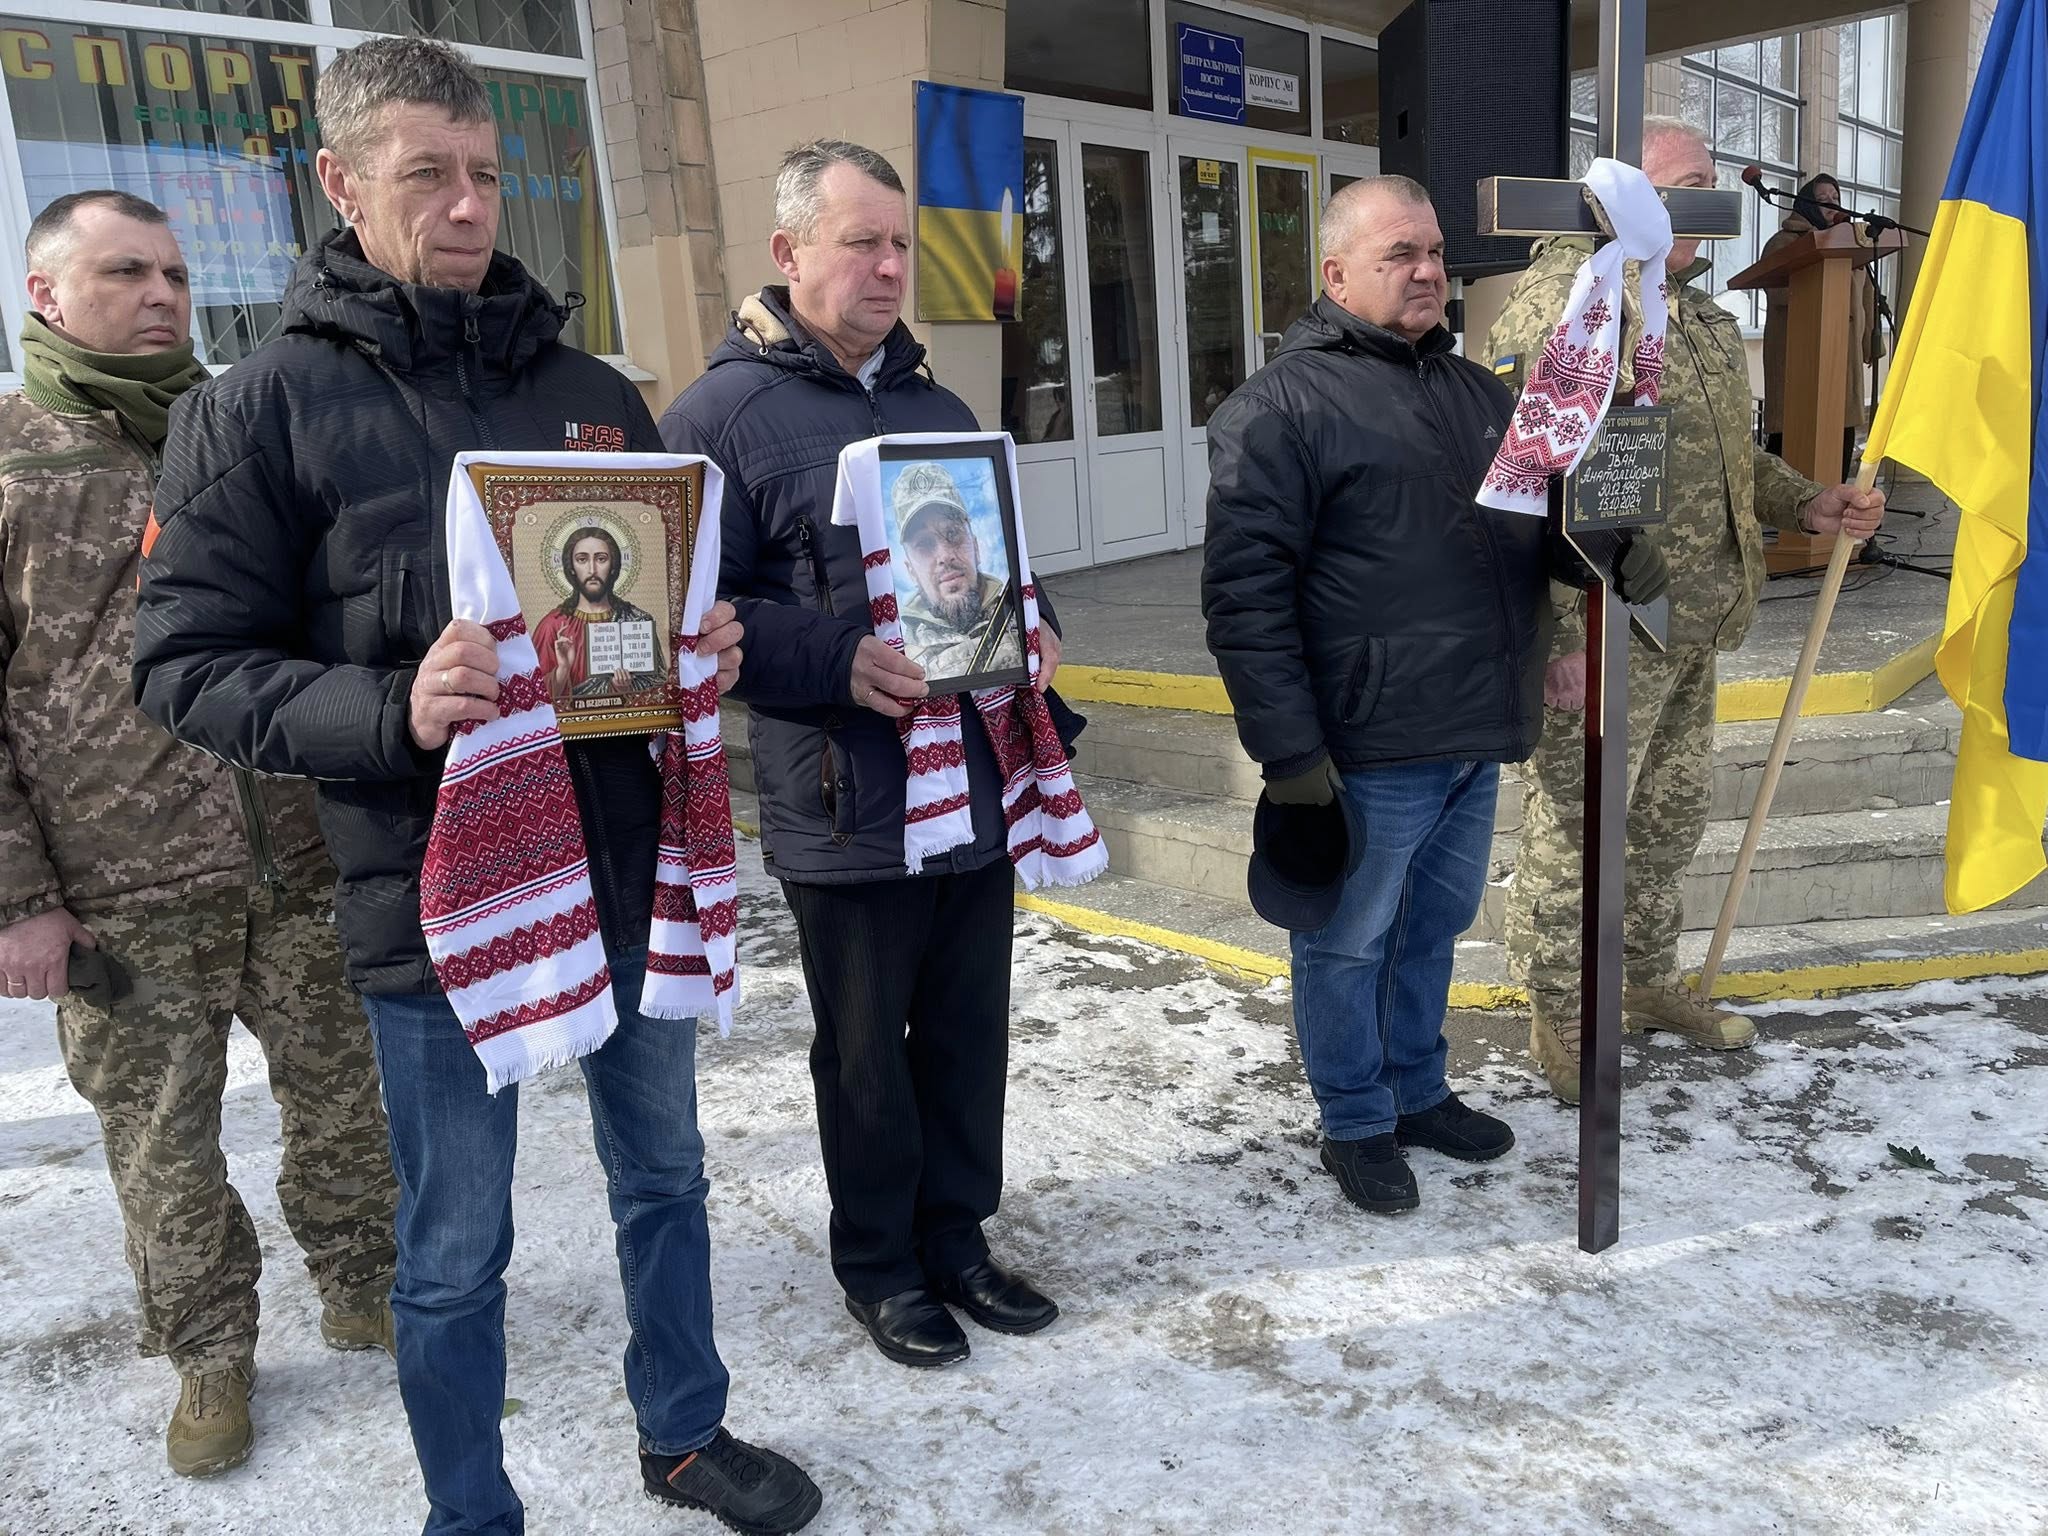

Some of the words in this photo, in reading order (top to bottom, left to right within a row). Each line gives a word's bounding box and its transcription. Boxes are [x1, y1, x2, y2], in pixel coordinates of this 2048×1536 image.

[0, 28, 312, 101] СПОРТ
[1249, 73, 1281, 91] КОРПУС
[1282, 80, 1294, 93] №1
[580, 423, 625, 446] FAS
